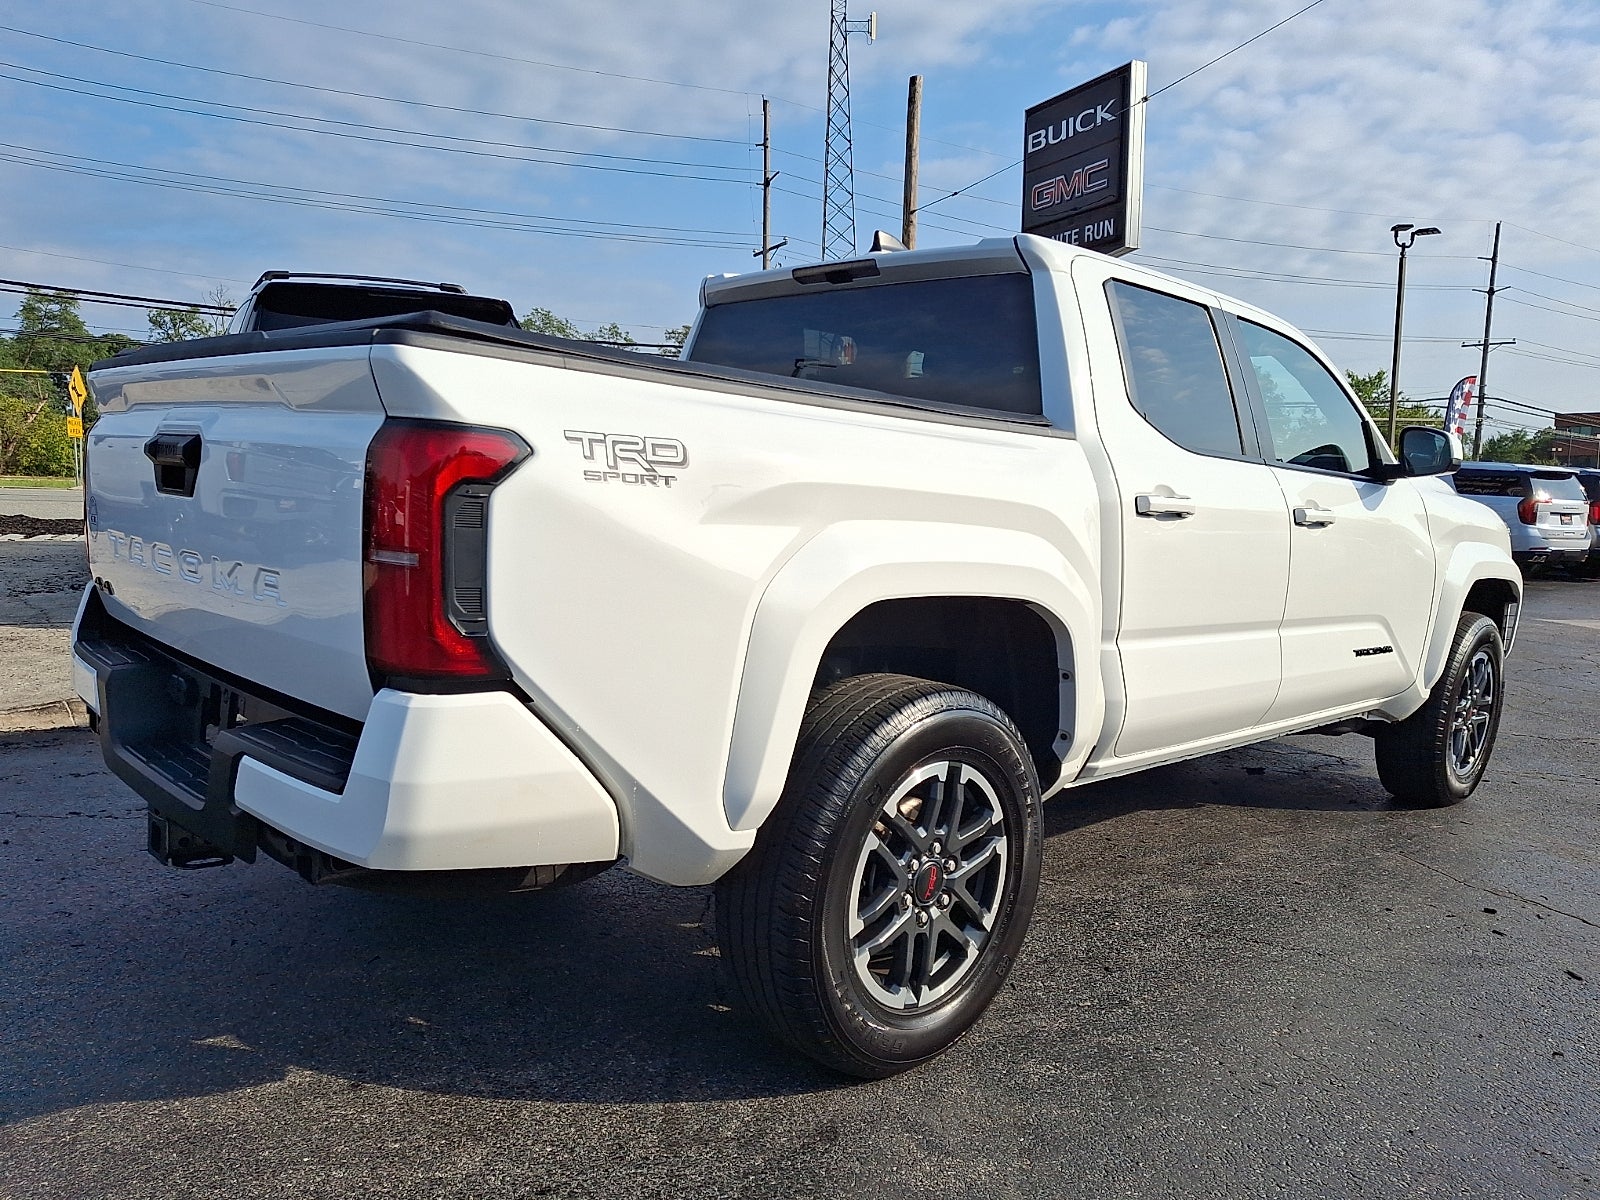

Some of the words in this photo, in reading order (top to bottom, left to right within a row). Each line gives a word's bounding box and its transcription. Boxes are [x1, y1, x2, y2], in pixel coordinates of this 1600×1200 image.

[1027, 98, 1118, 154] BUICK
[1031, 158, 1109, 211] GMC
[1084, 218, 1114, 243] RUN
[564, 430, 688, 472] TRD
[583, 470, 677, 488] SPORT
[107, 528, 288, 607] TACOMA
